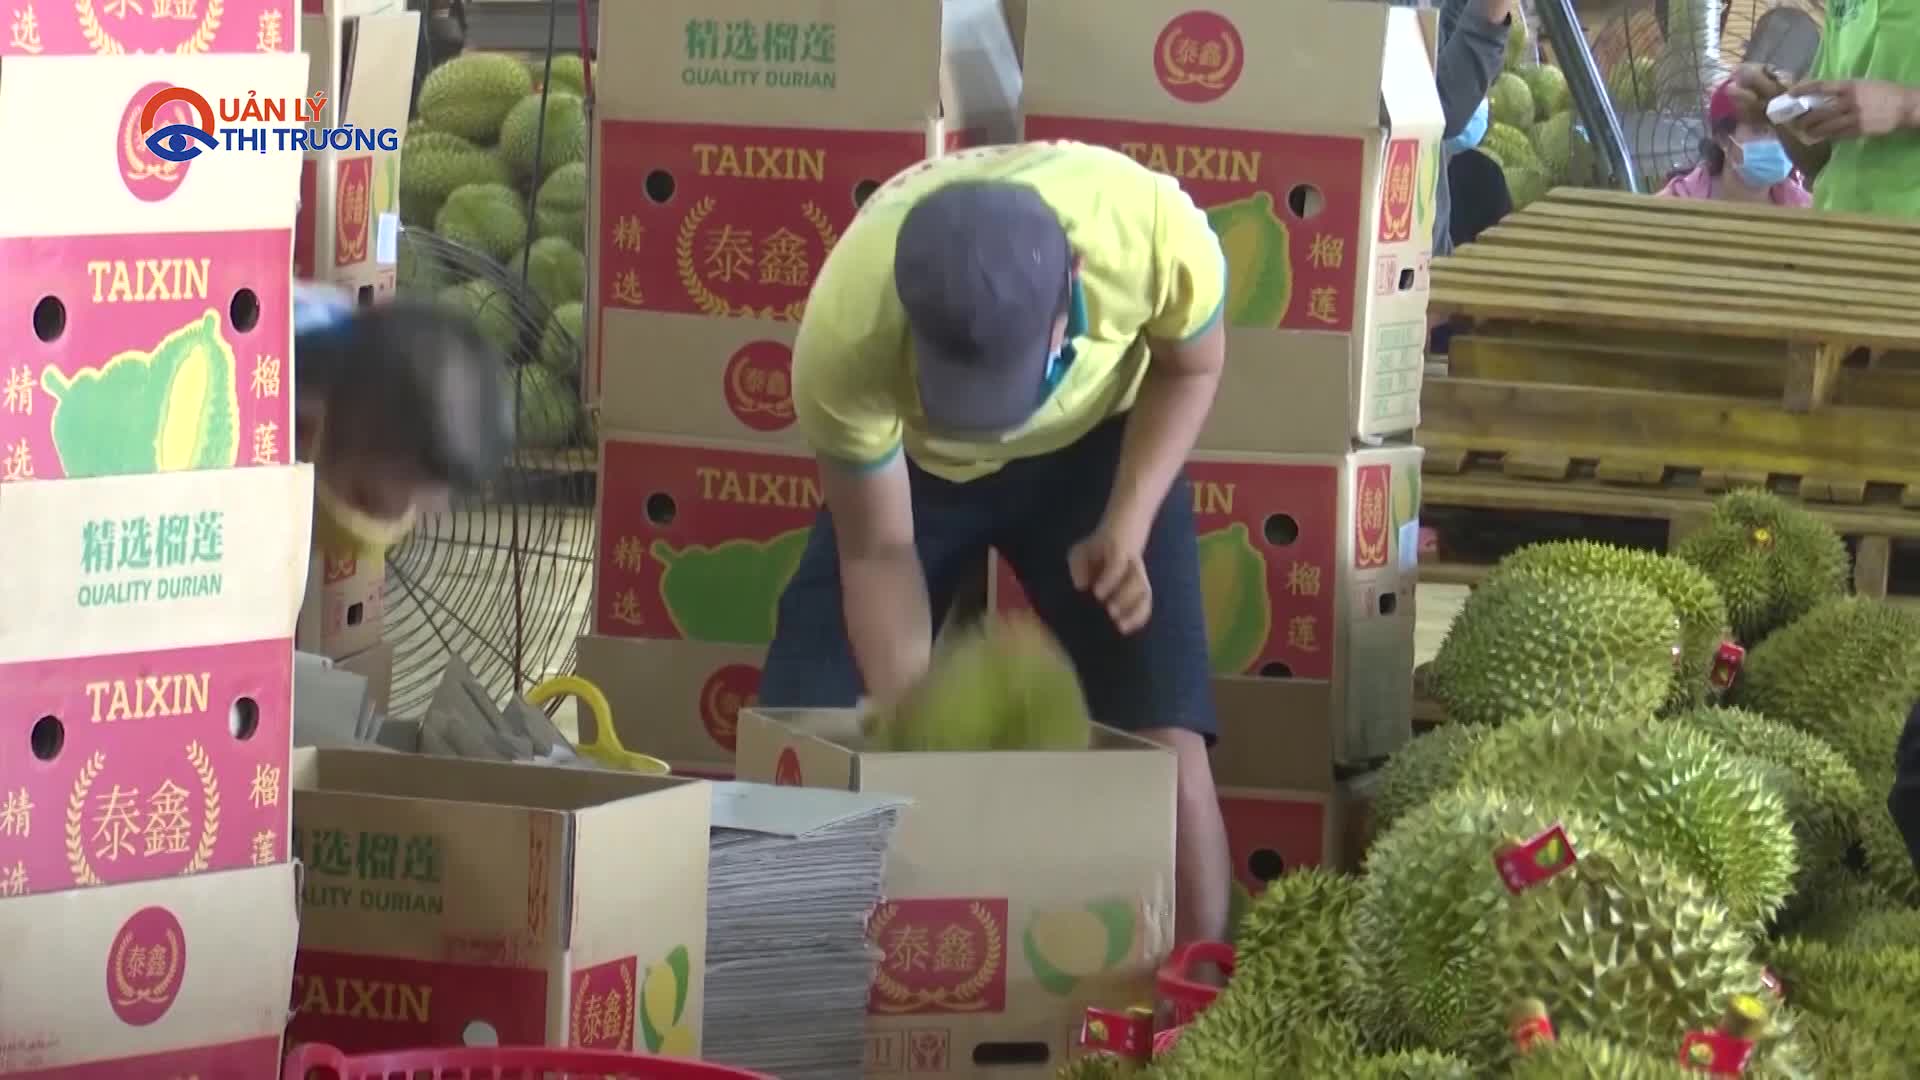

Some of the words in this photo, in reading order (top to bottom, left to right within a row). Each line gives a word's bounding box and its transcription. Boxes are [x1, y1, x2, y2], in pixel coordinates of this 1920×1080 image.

[682, 68, 760, 87] QUALITY
[766, 71, 836, 89] DURIAN
[693, 144, 827, 181] TAIXIN
[703, 224, 809, 286] 泰鑫
[88, 258, 211, 303] TAIXIN
[77, 580, 153, 607] QUALITY
[157, 574, 222, 600] DURIAN
[86, 672, 211, 723] TAIXIN
[91, 779, 192, 861] 泰鑫
[360, 889, 443, 915] DURIAN
